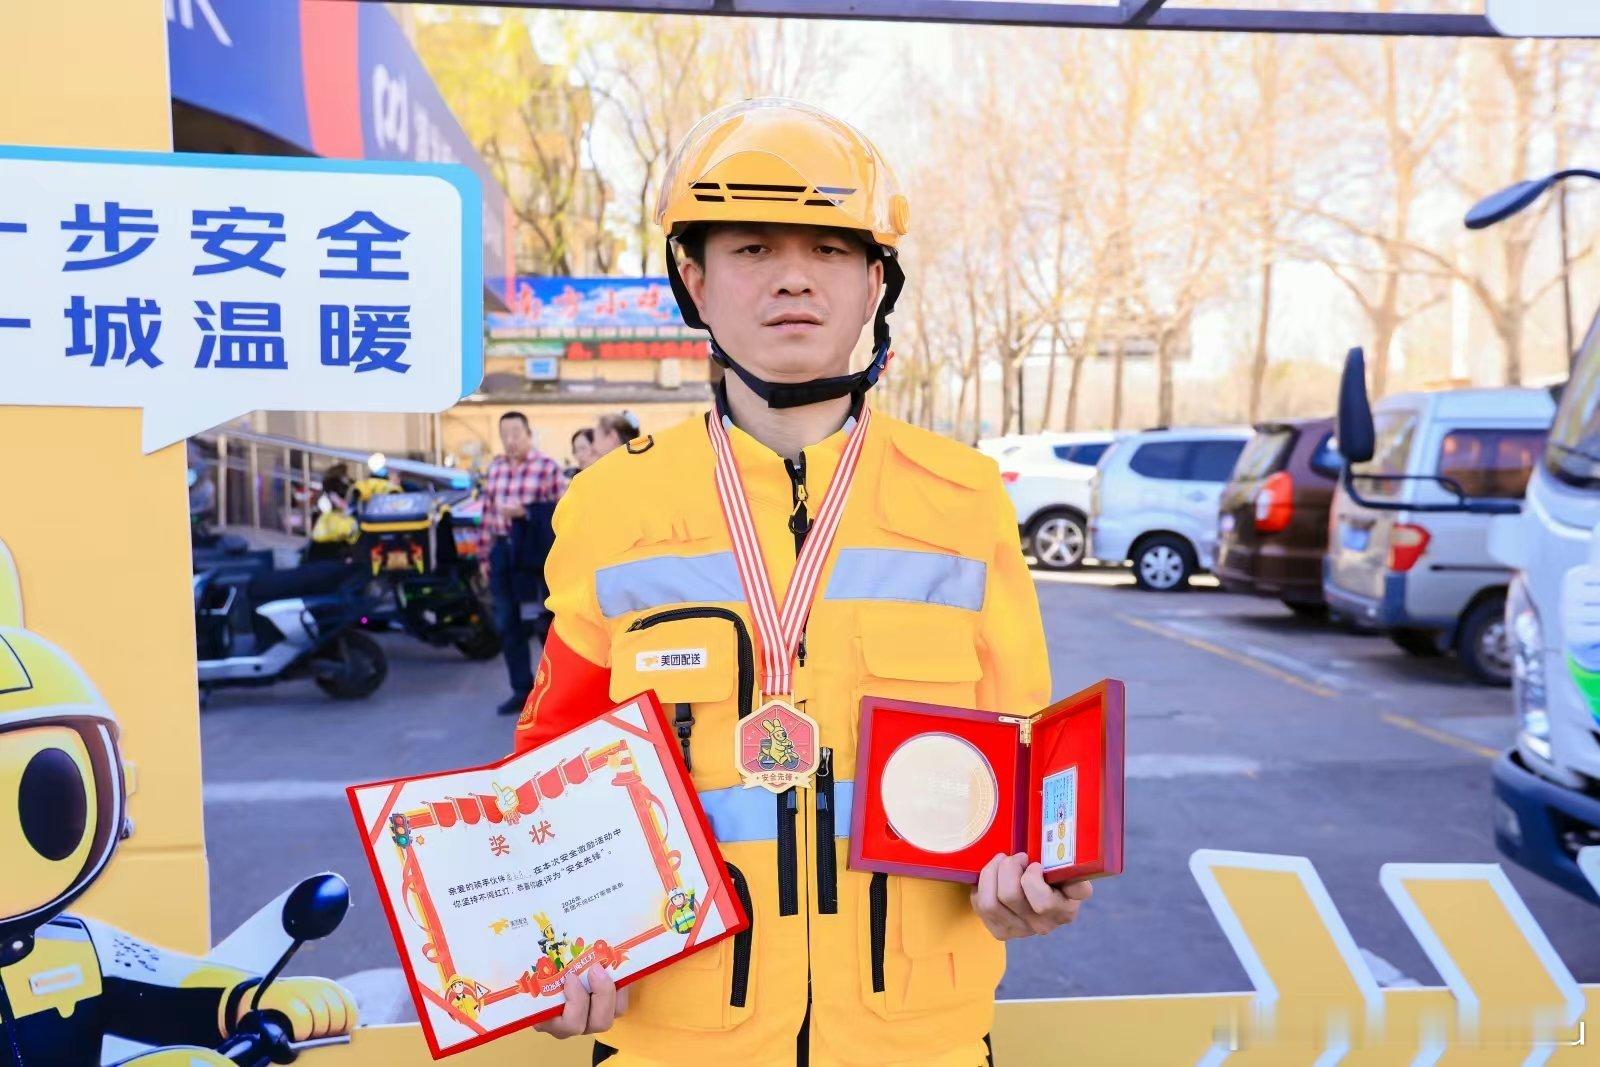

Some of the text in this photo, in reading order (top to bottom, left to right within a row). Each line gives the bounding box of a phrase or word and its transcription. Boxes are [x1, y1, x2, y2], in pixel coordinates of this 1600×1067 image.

[0, 202, 411, 281] 步安全
[0, 295, 412, 375] 城温暖
[661, 653, 701, 667] 美团配送
[761, 773, 793, 782] 安全先锋
